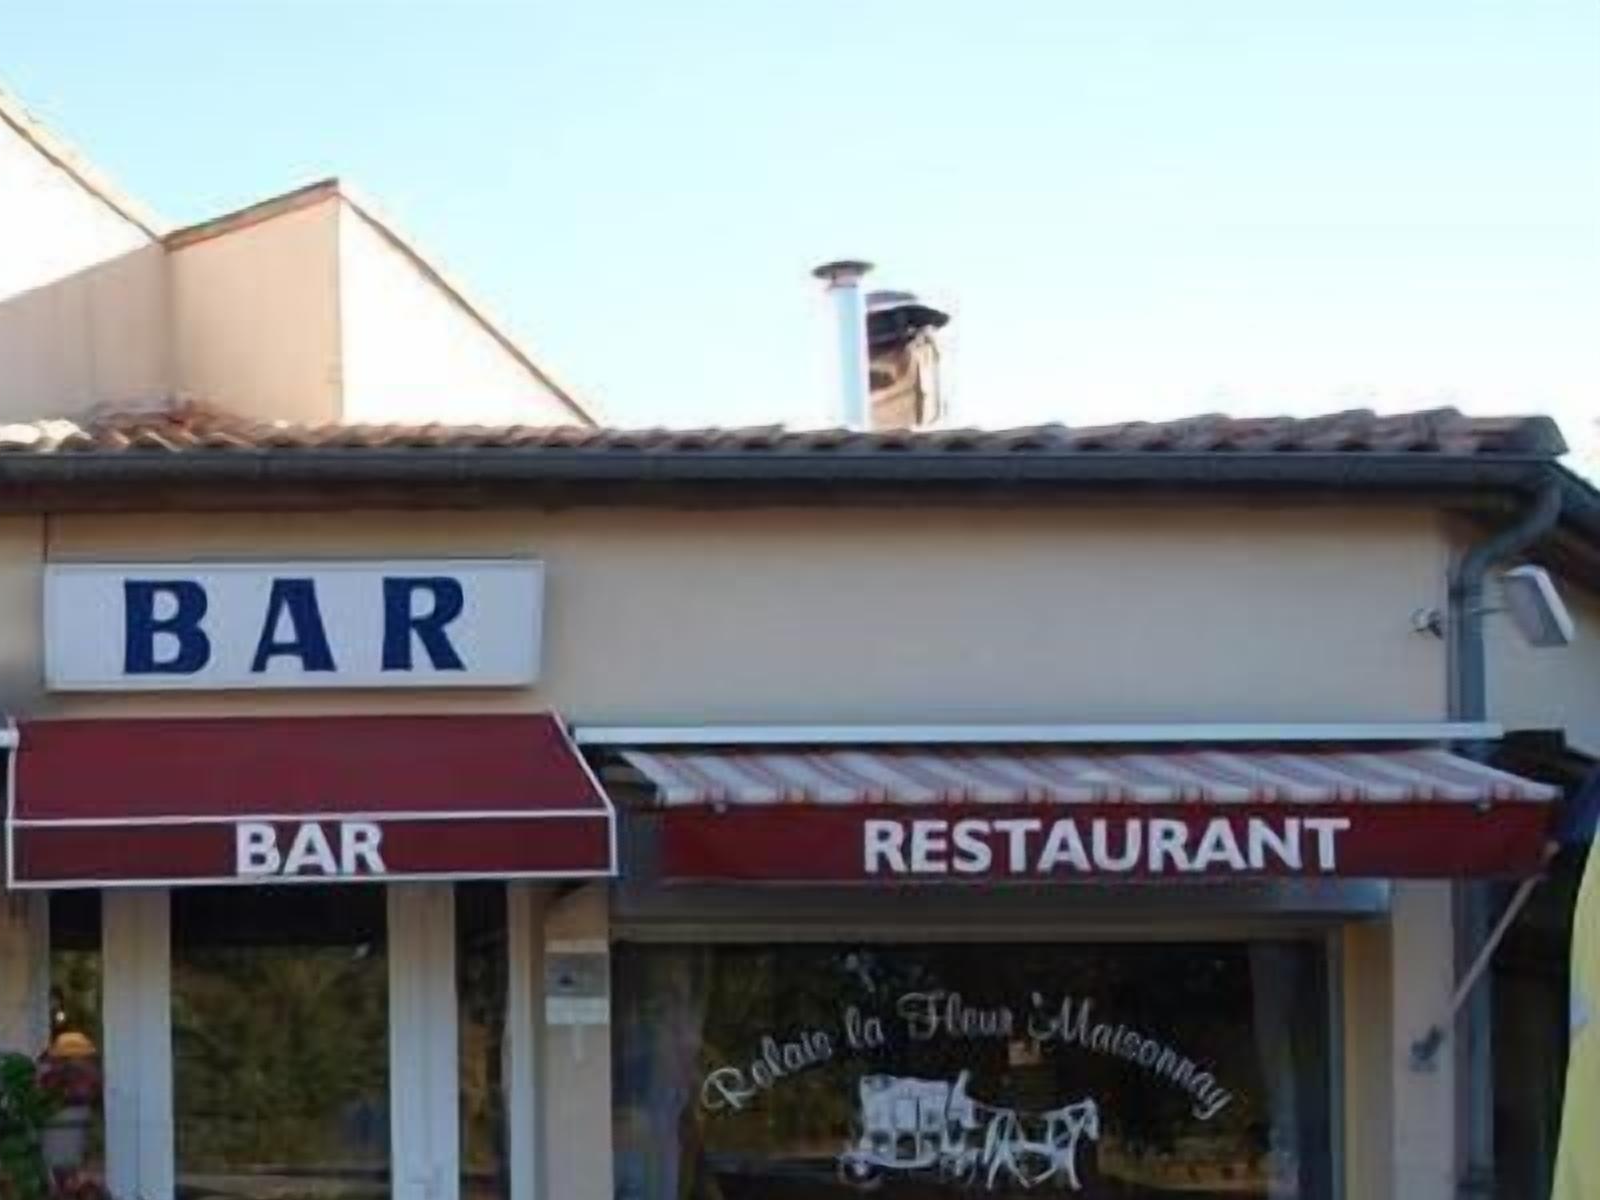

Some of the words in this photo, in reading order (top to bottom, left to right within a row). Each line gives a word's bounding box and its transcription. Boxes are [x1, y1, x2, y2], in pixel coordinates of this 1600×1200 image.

[123, 576, 467, 674] BAR
[234, 821, 387, 877] BAR
[863, 817, 1351, 873] RESTAURANT
[702, 1032, 833, 1110] Relais
[846, 1005, 885, 1048] la
[897, 990, 1014, 1041] Fleur
[1026, 994, 1233, 1121] Maisonnay
